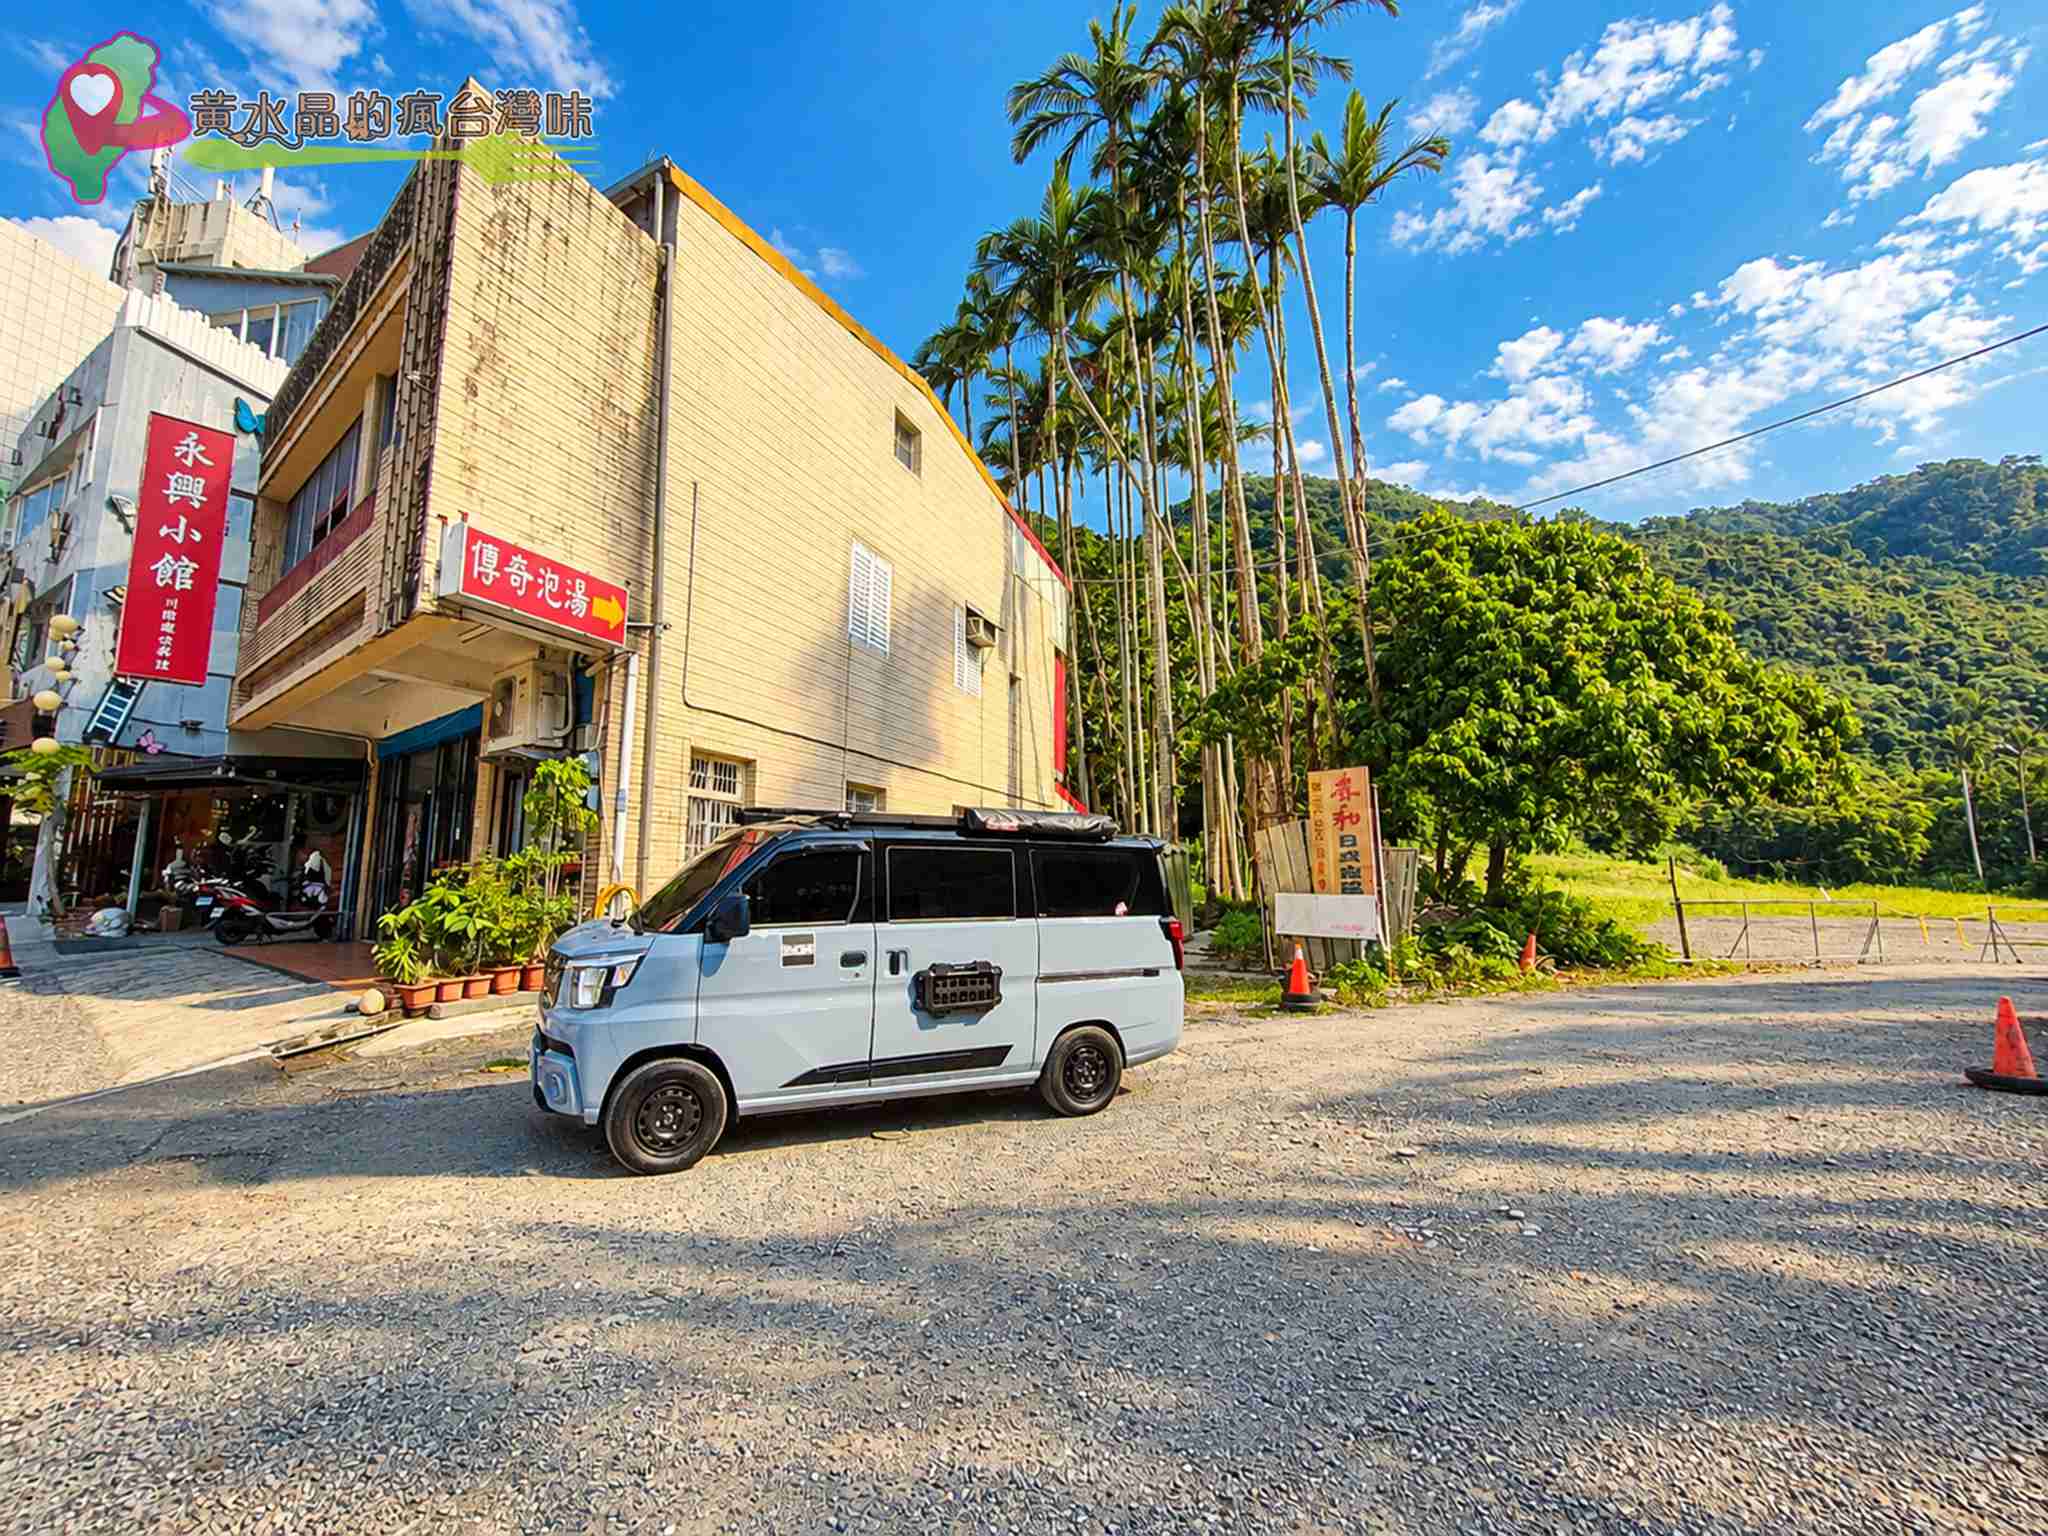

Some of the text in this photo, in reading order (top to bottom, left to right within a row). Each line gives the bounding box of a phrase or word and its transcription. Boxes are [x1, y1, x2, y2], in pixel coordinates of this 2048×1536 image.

[150, 432, 215, 591] 永興小館
[472, 540, 591, 618] 傳奇泡湯
